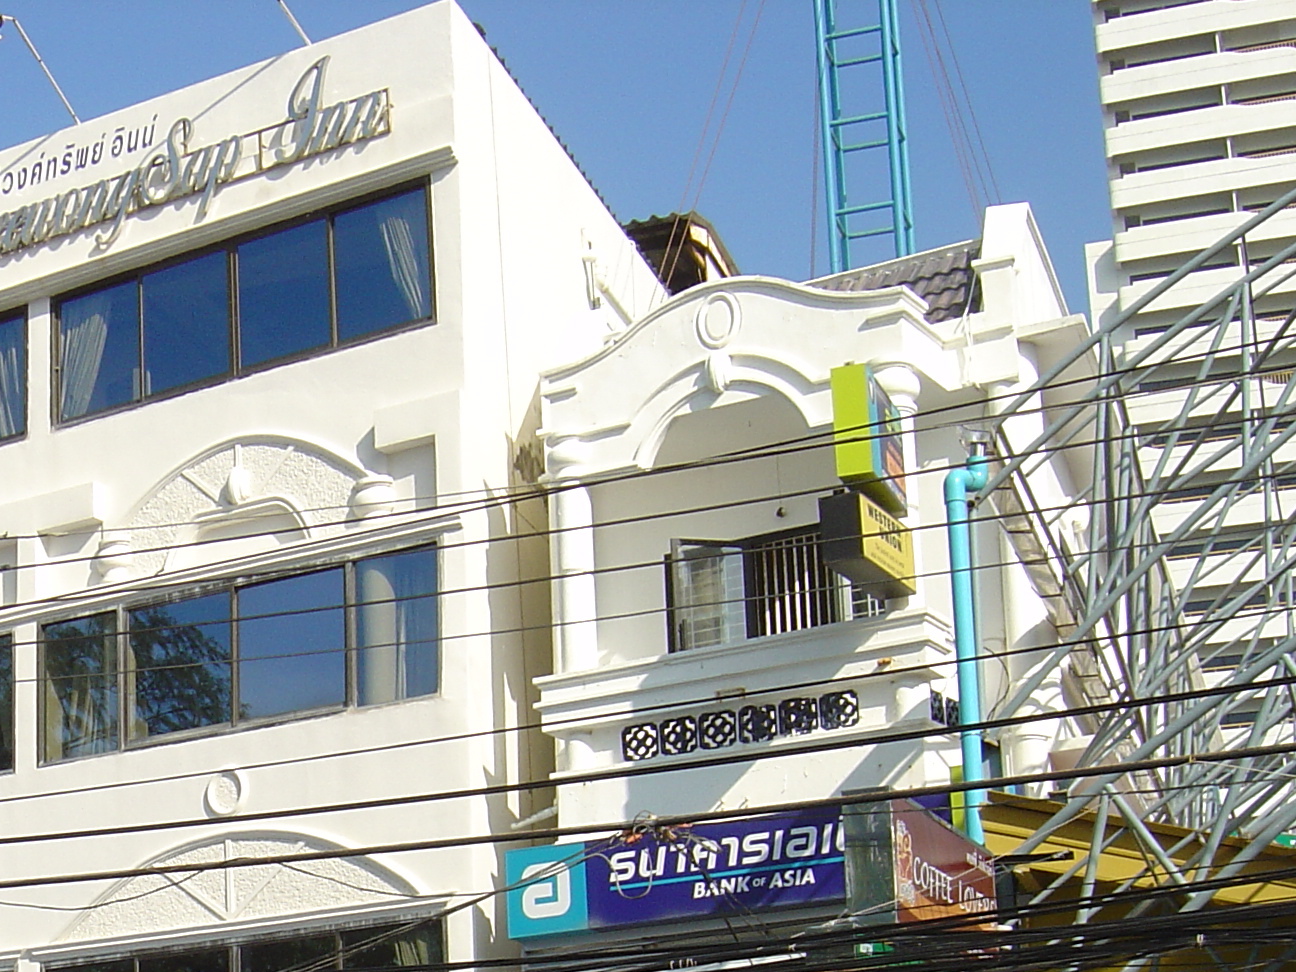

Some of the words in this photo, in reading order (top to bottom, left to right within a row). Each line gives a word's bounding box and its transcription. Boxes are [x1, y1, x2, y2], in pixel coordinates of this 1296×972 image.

[274, 54, 386, 166] Inn
[867, 503, 902, 540] WESTERN
[692, 874, 751, 900] BANK
[768, 867, 816, 890] ASIA
[913, 856, 954, 904] COFFEE
